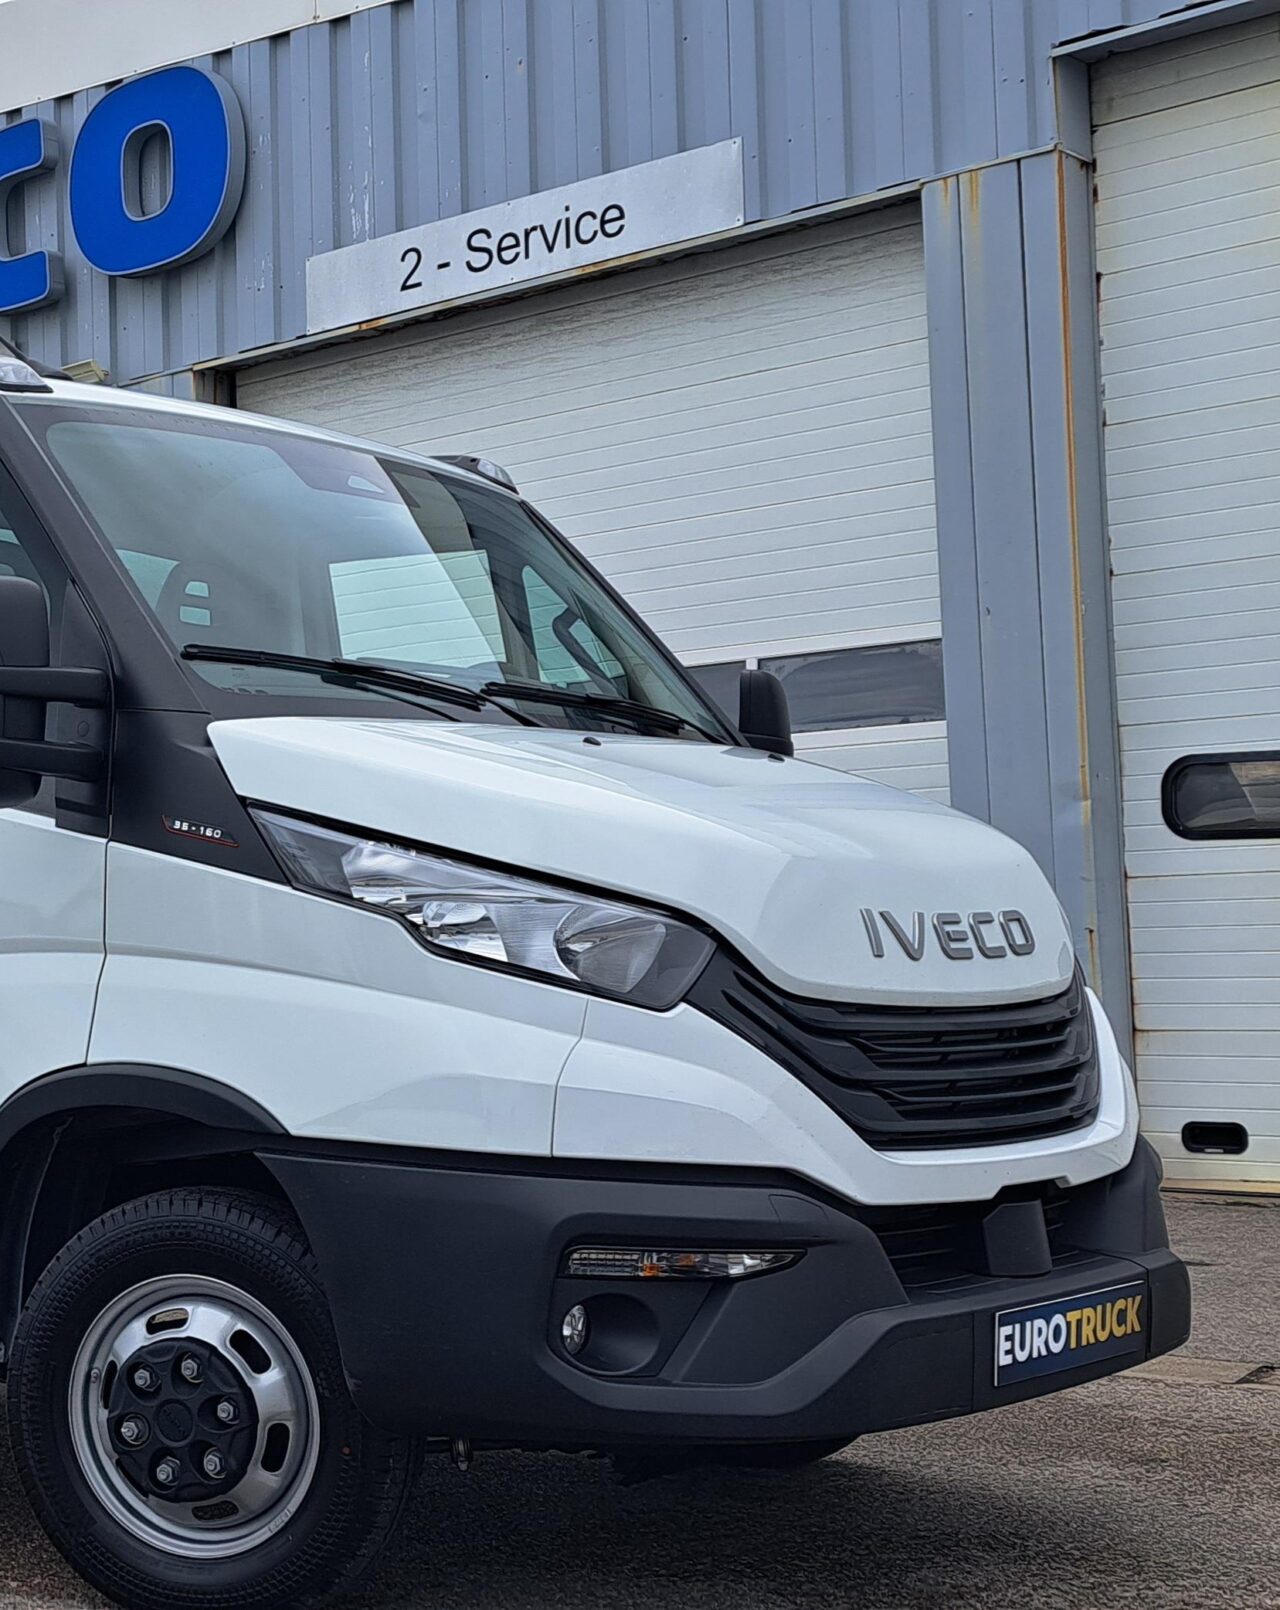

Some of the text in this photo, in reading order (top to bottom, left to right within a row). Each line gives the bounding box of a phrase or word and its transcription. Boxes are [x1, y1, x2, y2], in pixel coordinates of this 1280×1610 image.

[399, 246, 423, 292] 2
[465, 202, 627, 274] Service
[859, 907, 1036, 962] IVECO
[998, 1294, 1144, 1367] EUROTRUCK
